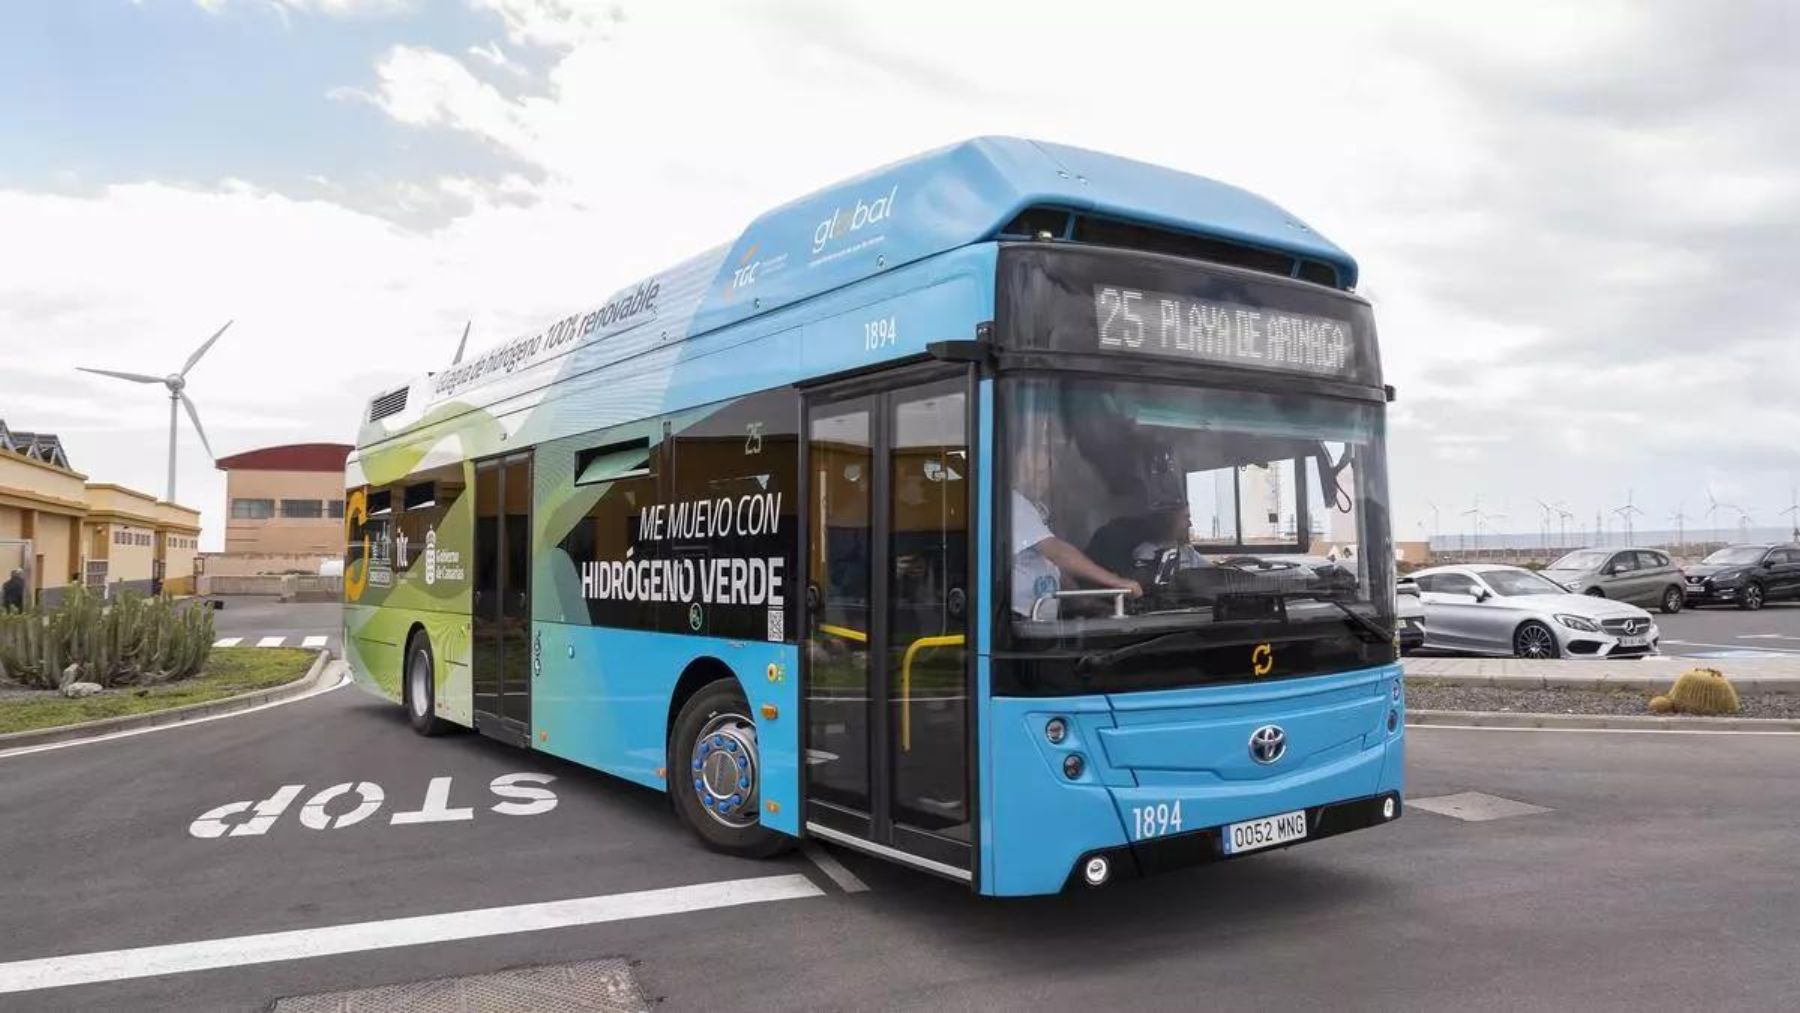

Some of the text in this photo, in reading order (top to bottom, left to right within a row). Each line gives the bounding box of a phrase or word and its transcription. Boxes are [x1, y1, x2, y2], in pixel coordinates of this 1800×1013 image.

[733, 261, 760, 288] TGC
[543, 312, 582, 351] 100%
[577, 278, 660, 338] renovable
[864, 316, 896, 351] 1894
[1099, 288, 1346, 369] 25 PLAYA DE ARINAGA
[745, 421, 763, 456] 25
[638, 492, 782, 541] ME MUEVO CON
[581, 546, 784, 606] HIDRÓGENO VERDE
[189, 772, 559, 838] STOP
[1133, 800, 1182, 839] 1894
[1234, 814, 1305, 848] 0052 MNG
